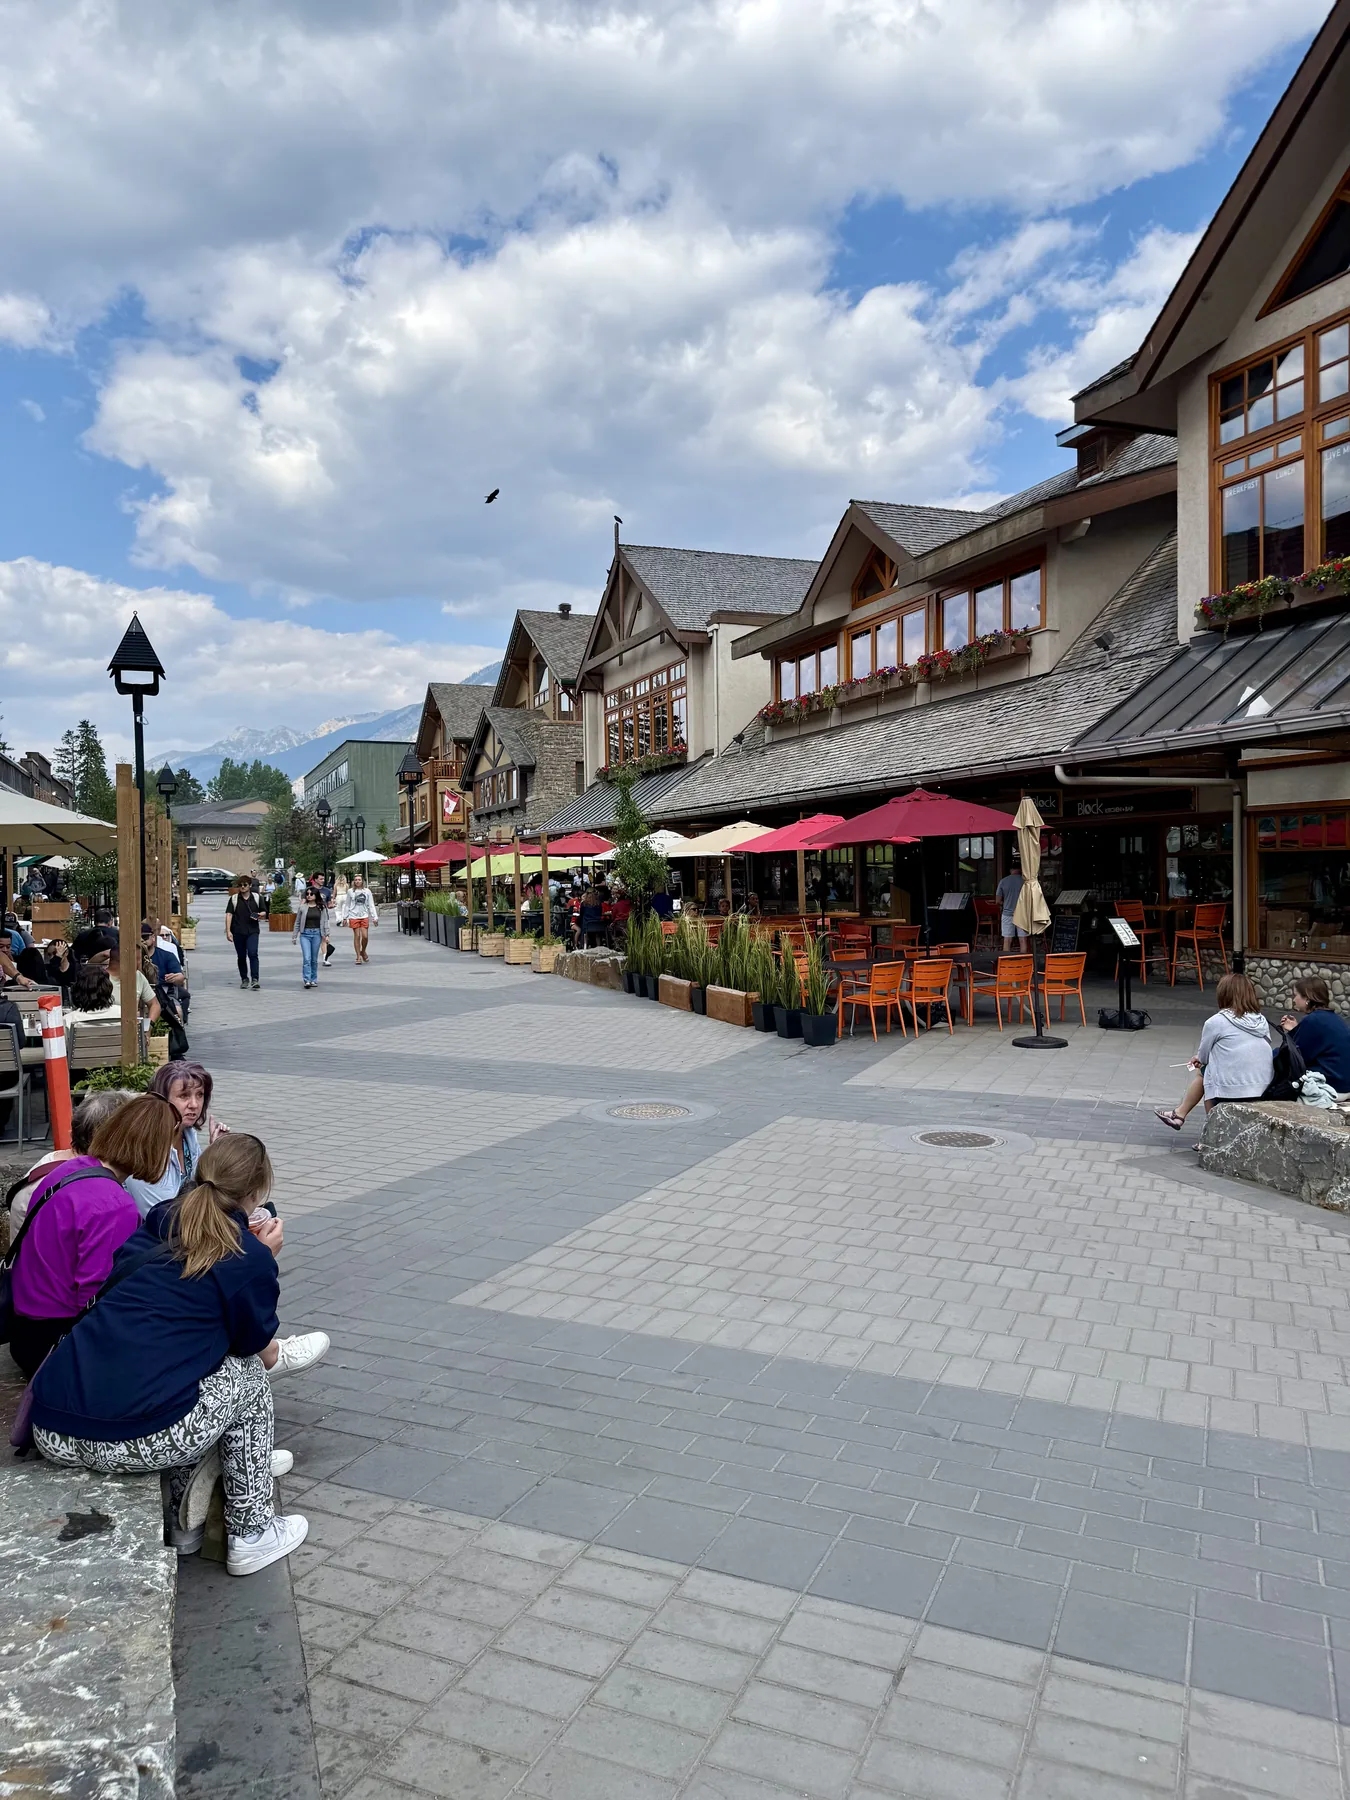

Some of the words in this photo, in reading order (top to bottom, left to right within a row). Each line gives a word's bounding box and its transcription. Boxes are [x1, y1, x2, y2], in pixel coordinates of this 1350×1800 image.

[1325, 448, 1341, 461] LIVE
[1275, 466, 1296, 480] LUNCH
[1225, 480, 1259, 498] BREAKFAST
[1077, 798, 1104, 816] Block
[201, 834, 224, 851] Banff
[224, 835, 245, 851] Park
